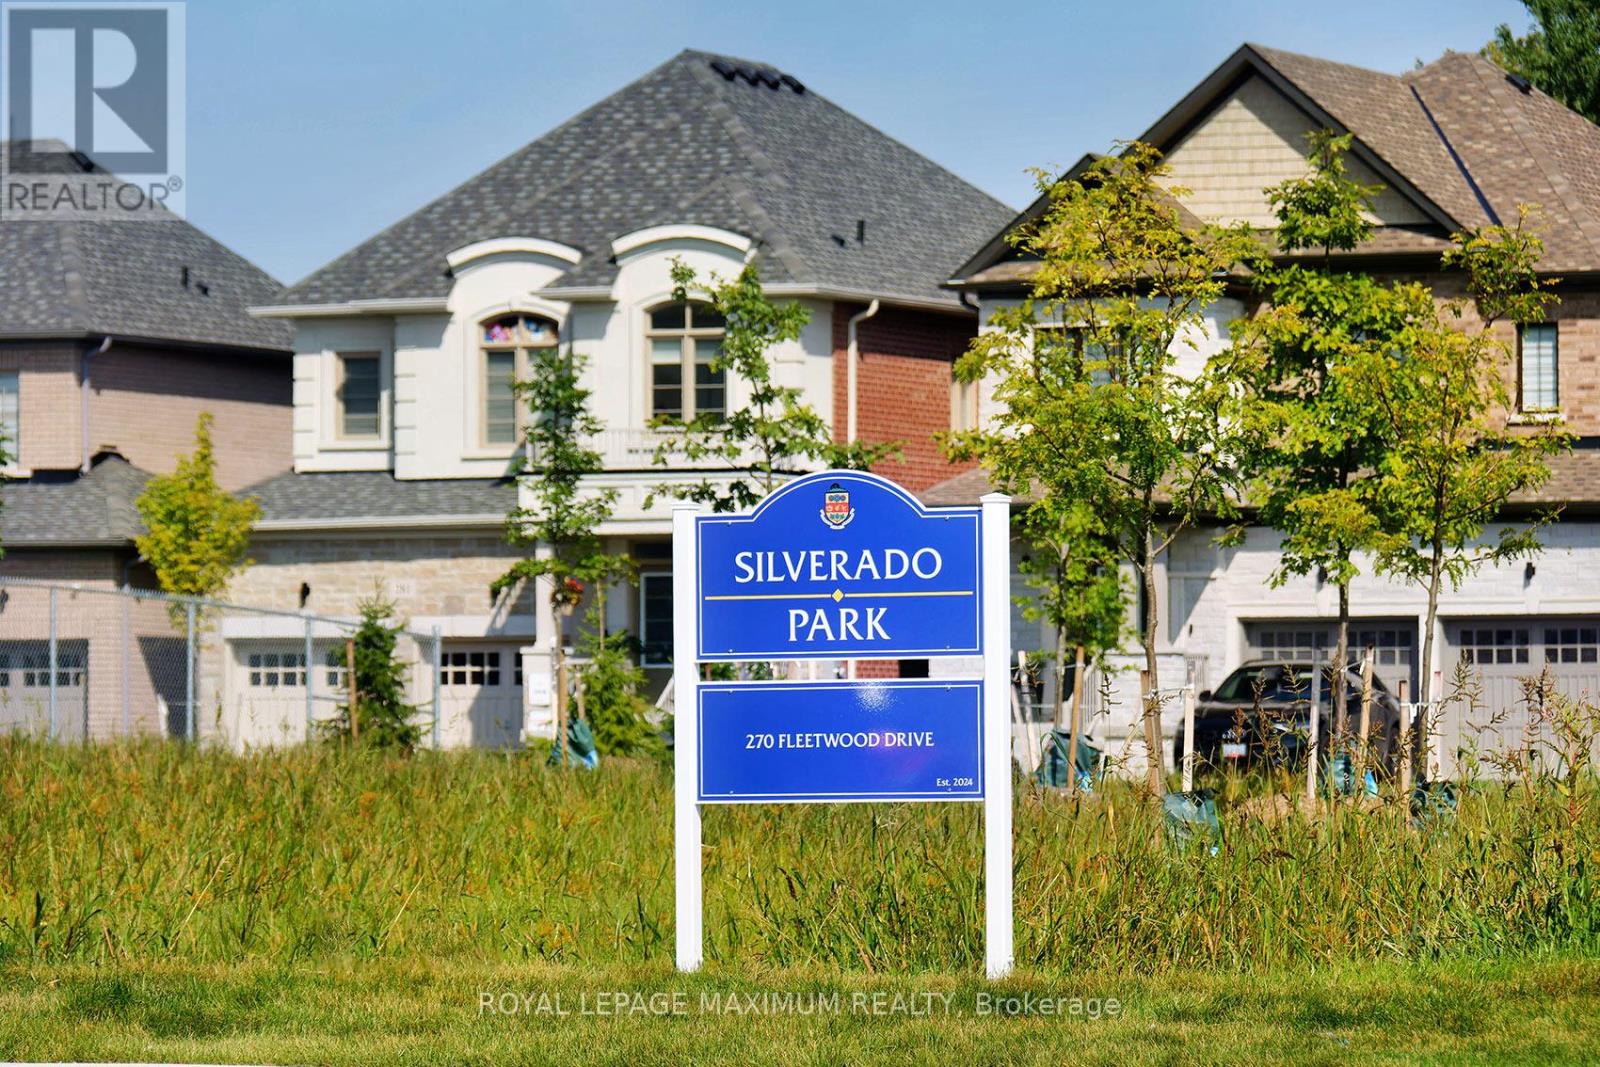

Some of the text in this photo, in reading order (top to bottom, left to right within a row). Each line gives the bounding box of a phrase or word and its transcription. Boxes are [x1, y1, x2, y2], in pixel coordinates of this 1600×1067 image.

[734, 547, 943, 584] SILVERADO
[788, 607, 892, 642] PARK
[745, 731, 935, 749] 270 FLEETWOOD DRIVE
[936, 777, 974, 787] Est. 2024
